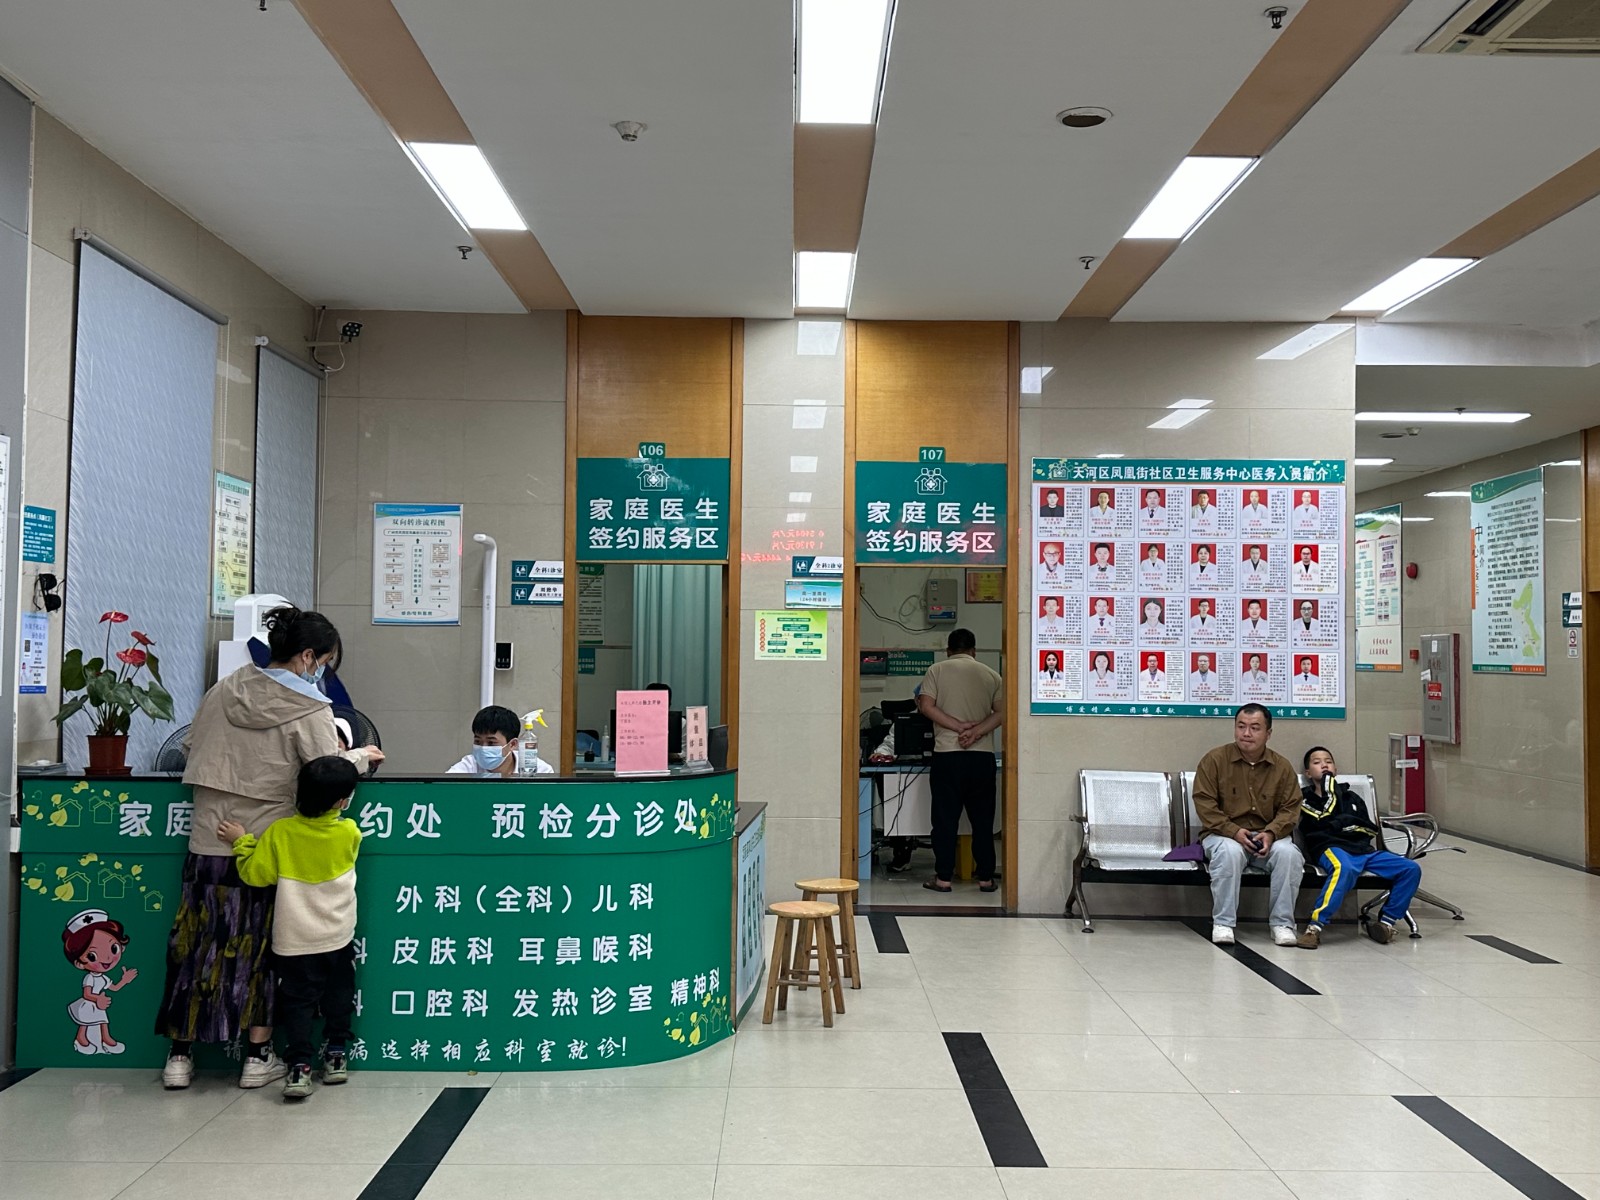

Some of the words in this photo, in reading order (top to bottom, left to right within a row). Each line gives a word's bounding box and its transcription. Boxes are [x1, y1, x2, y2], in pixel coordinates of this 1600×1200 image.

[641, 444, 664, 457] 106
[920, 449, 943, 461] 107
[1073, 465, 1329, 482] 天河区凤凰街社区卫生服务中心医务人员简介
[589, 497, 719, 521] 家庭医生
[867, 501, 996, 525] 家庭医生
[392, 518, 446, 527] 双向转诊流程图
[588, 526, 719, 550] 签约服务区
[866, 530, 996, 554] 签约服务区
[491, 798, 697, 839] 预检分诊处
[392, 936, 494, 965] 皮肤科
[518, 933, 653, 964] 耳鼻喉科
[391, 989, 489, 1018] 口腔科
[512, 984, 653, 1018] 发热诊室
[670, 966, 721, 1007] 精神科
